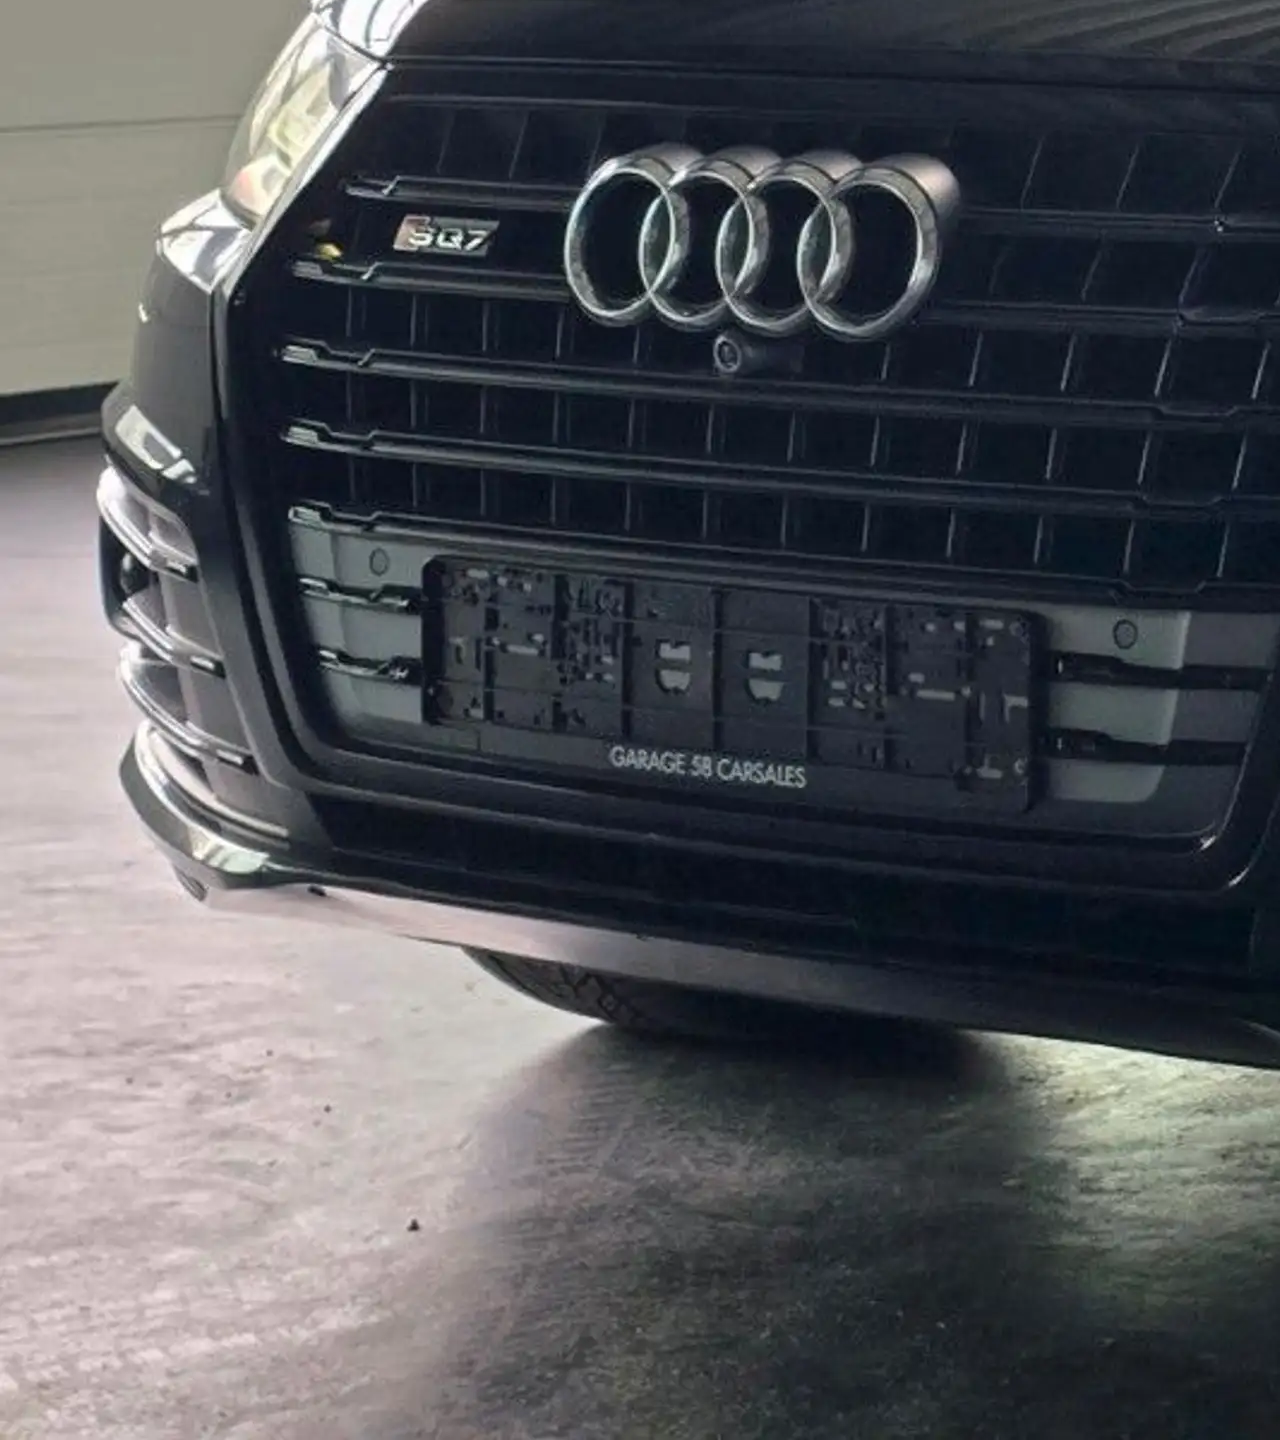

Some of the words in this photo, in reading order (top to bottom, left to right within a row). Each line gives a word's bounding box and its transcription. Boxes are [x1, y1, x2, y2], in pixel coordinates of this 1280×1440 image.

[405, 224, 491, 252] SQ7
[608, 745, 687, 774] GARAGE
[717, 758, 807, 789] CARSALES
